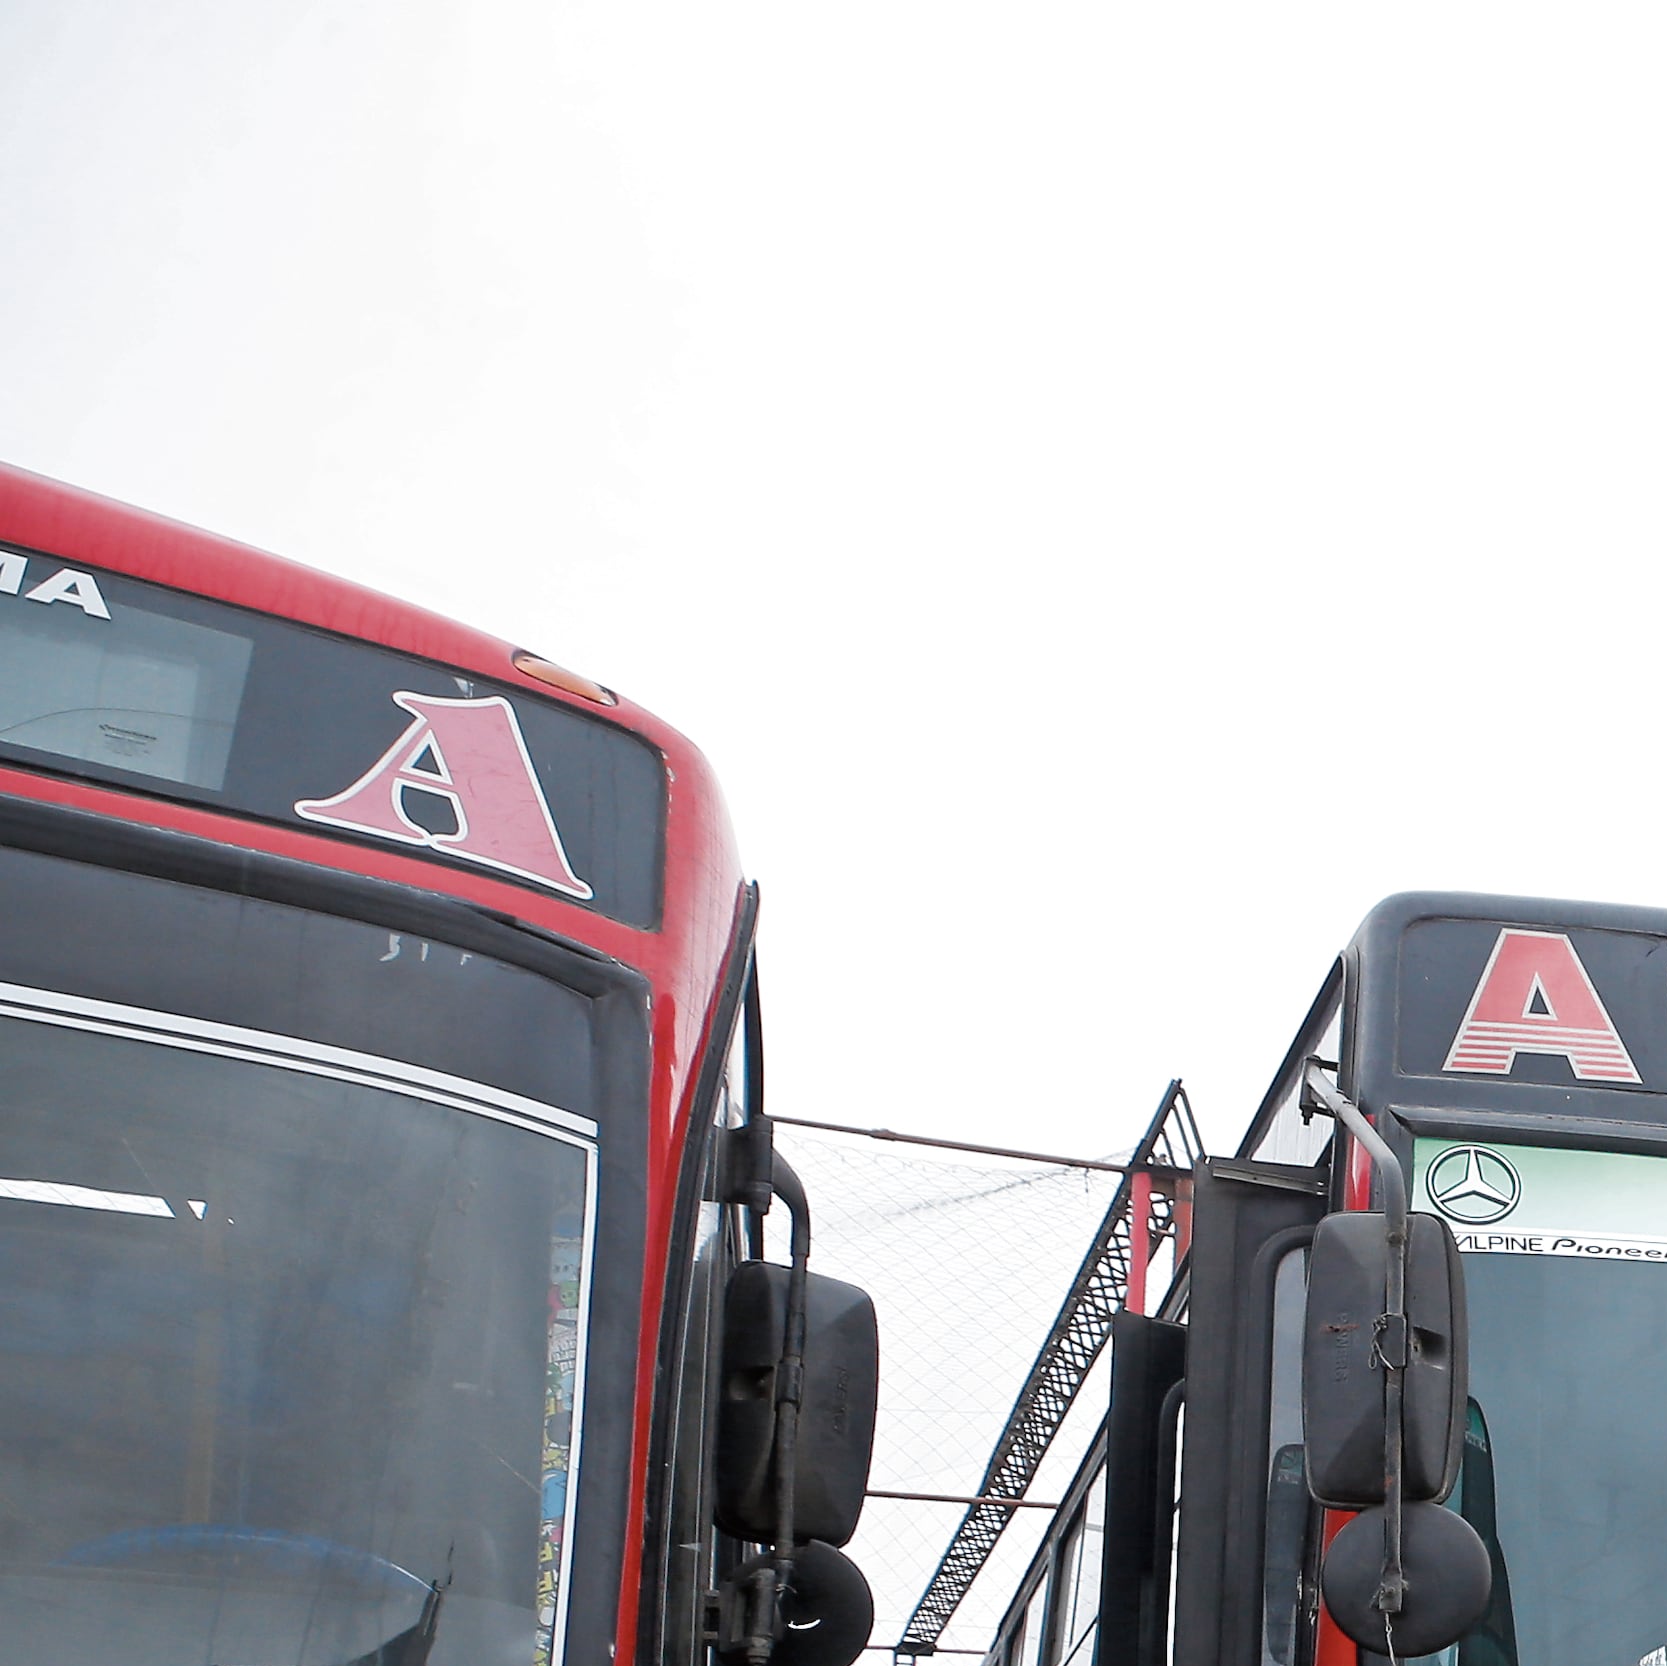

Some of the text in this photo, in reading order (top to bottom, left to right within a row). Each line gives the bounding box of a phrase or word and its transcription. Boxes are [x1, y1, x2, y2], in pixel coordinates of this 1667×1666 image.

[294, 690, 595, 899] A
[1442, 928, 1643, 1084] A
[1457, 1235, 1543, 1251] ALPINE
